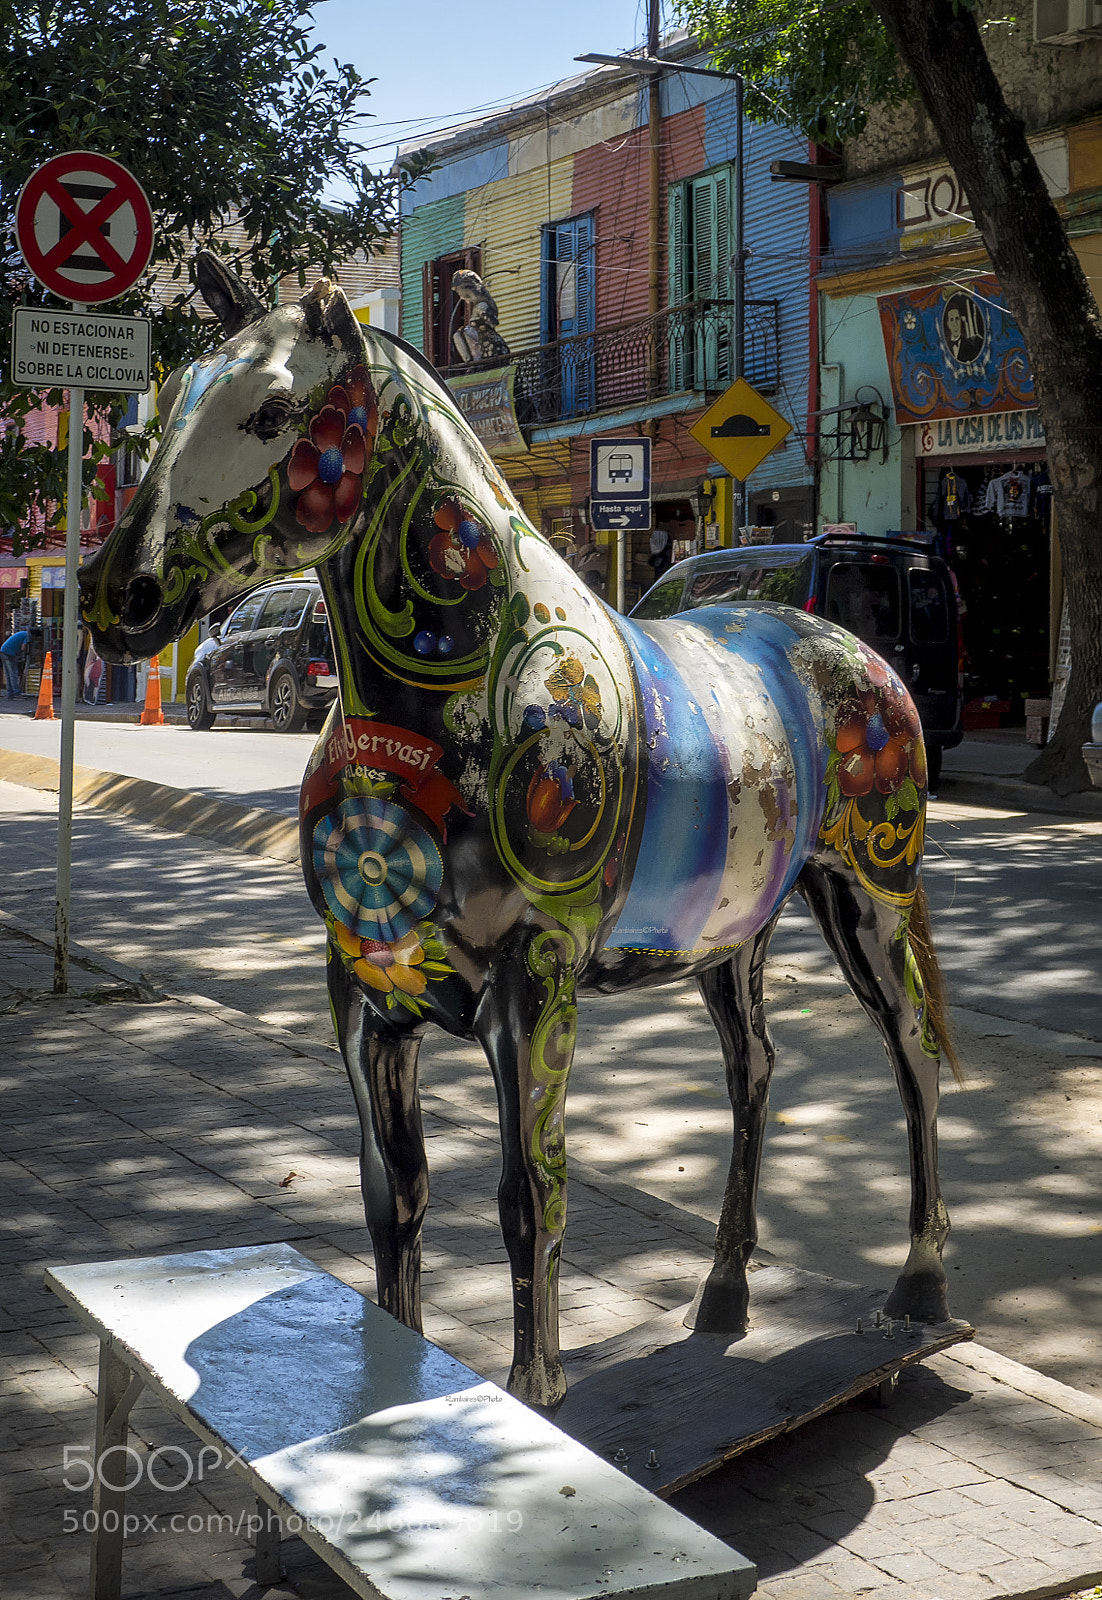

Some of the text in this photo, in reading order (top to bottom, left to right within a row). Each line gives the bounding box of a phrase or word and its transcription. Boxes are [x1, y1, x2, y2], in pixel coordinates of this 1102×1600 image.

[31, 320, 135, 340] NO ESTACIONAR
[36, 341, 128, 360] NI DETENERSE
[18, 361, 145, 382] SOBRE LA CICLOVIA
[938, 420, 953, 447] LA
[956, 416, 985, 446] CASA
[987, 413, 1005, 442] DE
[1005, 411, 1025, 441] LAS
[599, 505, 622, 513] Hasta
